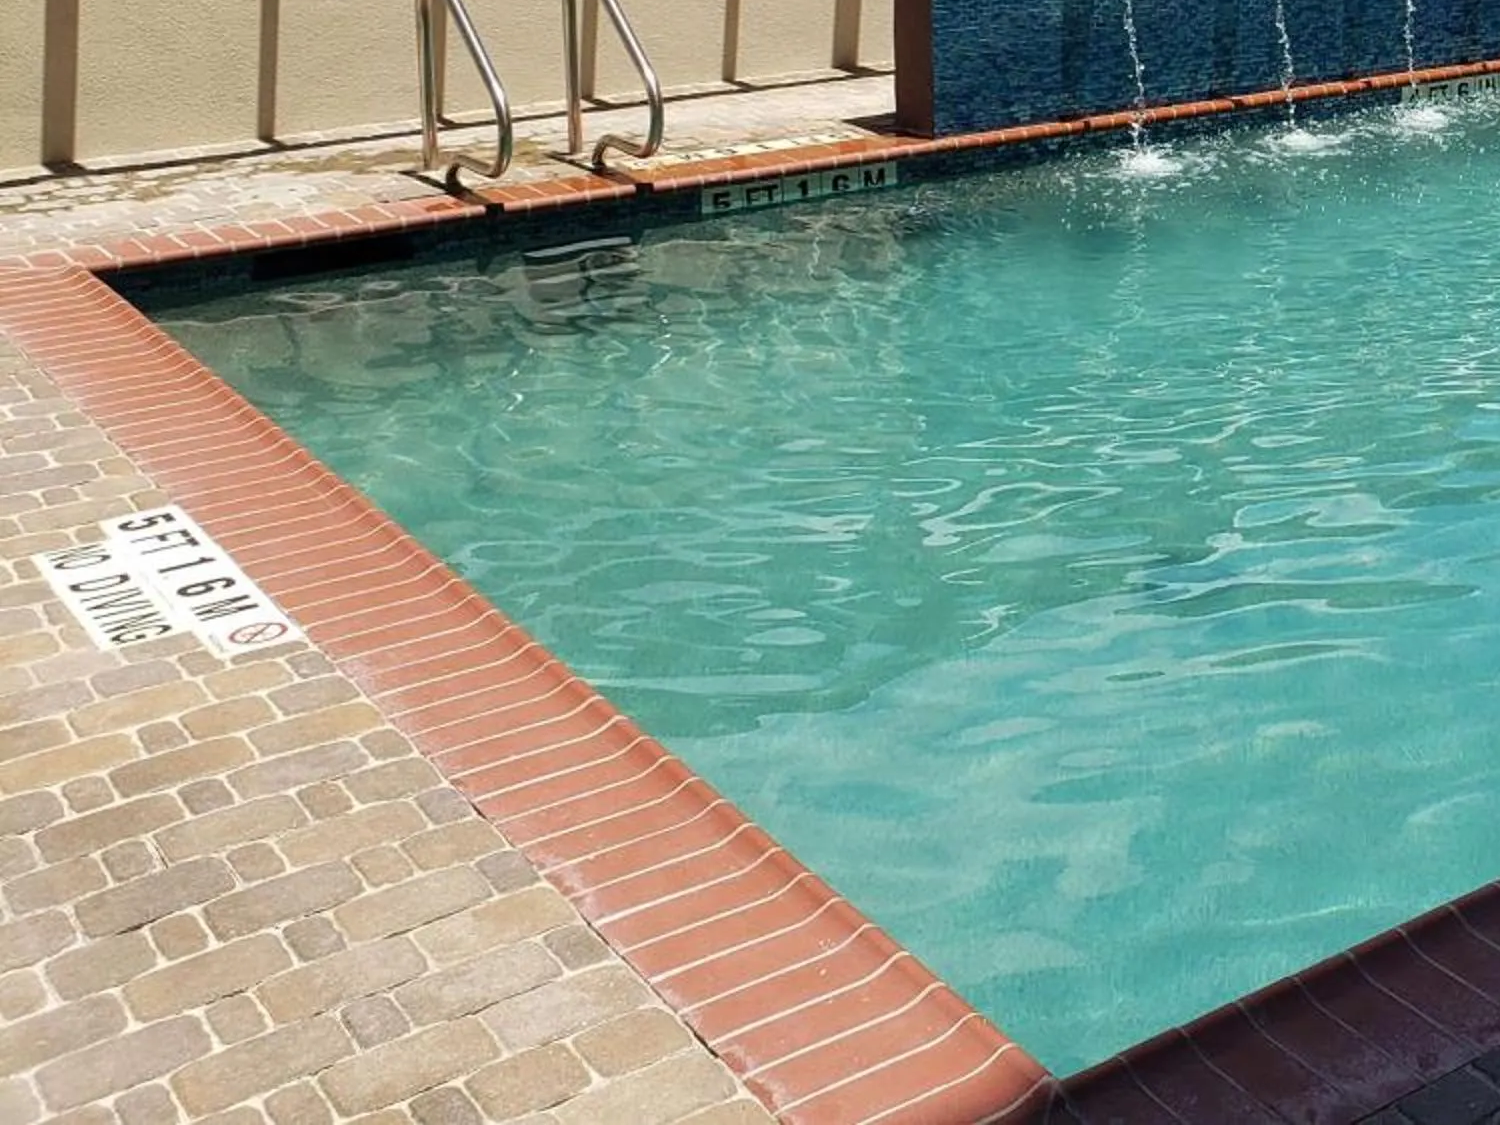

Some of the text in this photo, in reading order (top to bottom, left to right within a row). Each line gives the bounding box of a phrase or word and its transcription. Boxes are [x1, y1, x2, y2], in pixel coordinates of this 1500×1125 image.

[712, 192, 731, 209] 5
[746, 184, 778, 204] FT
[798, 179, 809, 197] 1
[864, 167, 886, 187] M
[44, 544, 172, 646] NO DIVING
[118, 512, 260, 622] 5 FT 1 6 M
